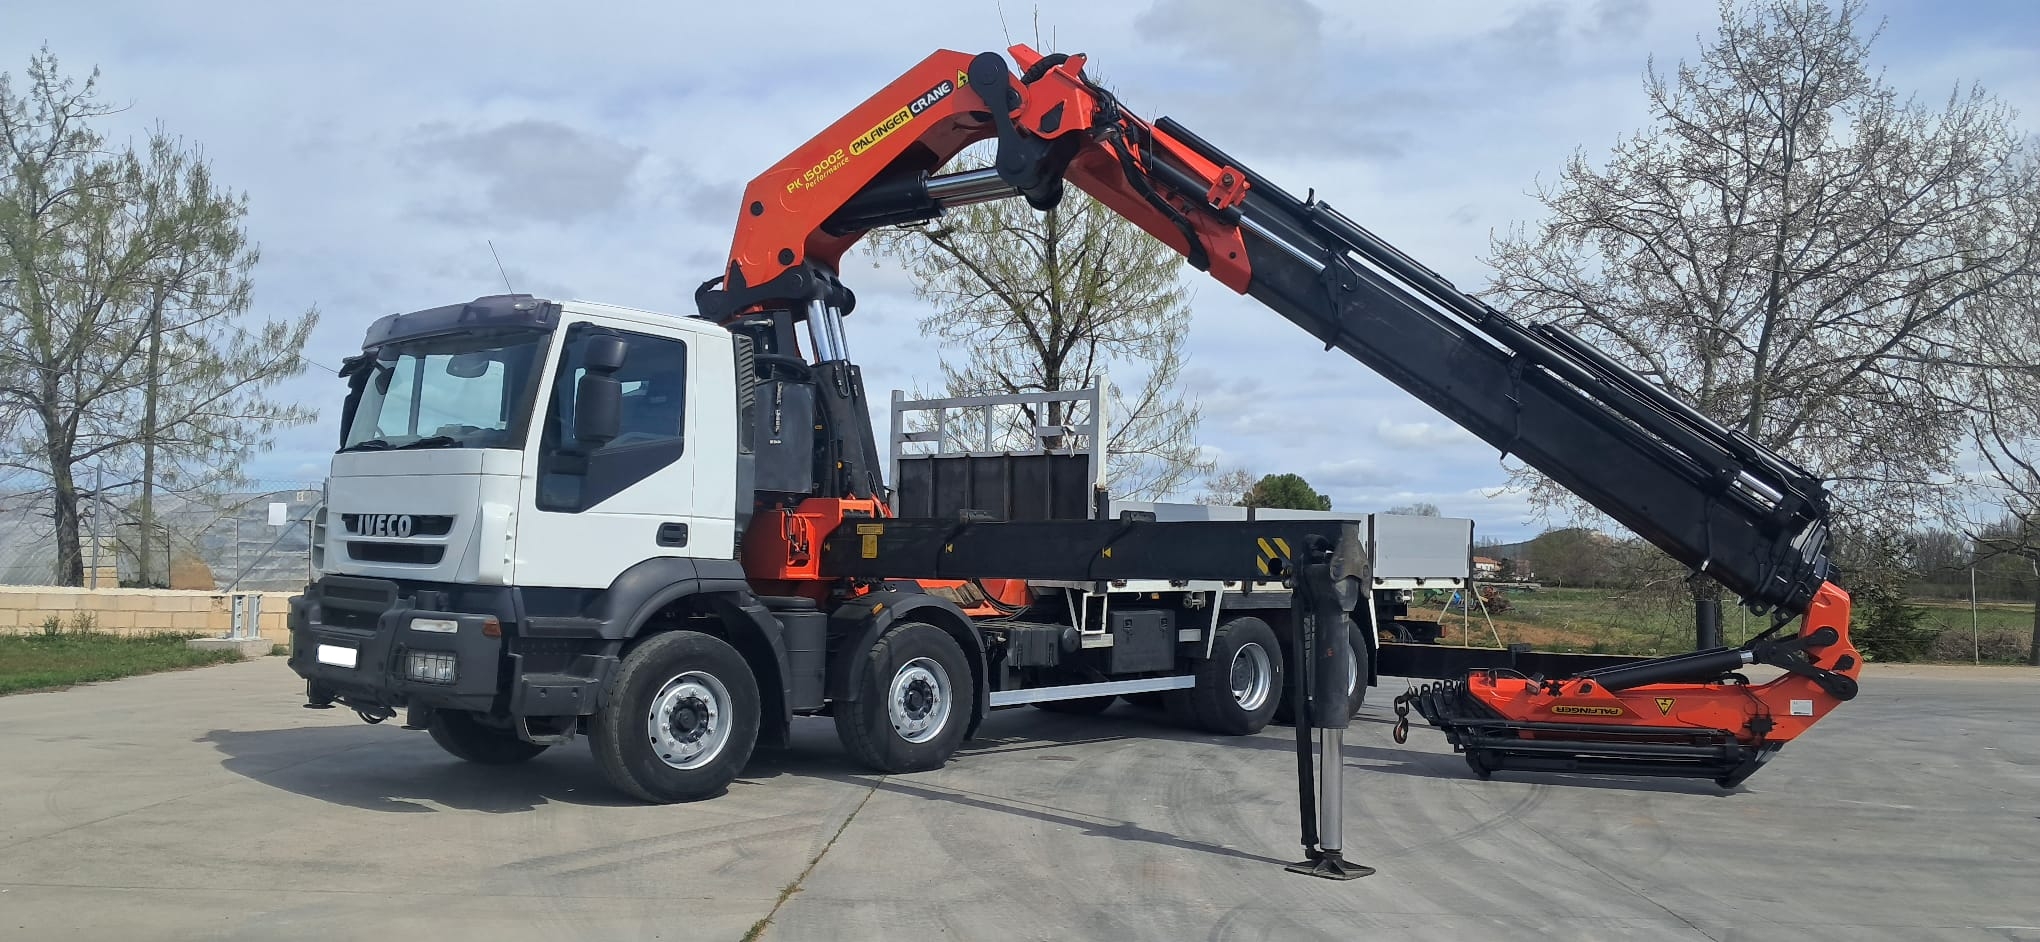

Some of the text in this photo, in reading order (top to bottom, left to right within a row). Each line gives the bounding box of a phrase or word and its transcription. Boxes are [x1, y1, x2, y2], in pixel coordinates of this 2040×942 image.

[852, 82, 951, 153] PALFINGER CRANE
[787, 149, 845, 193] PK 150002
[358, 514, 412, 538] IVECO
[1556, 706, 1618, 715] PALFINGER
